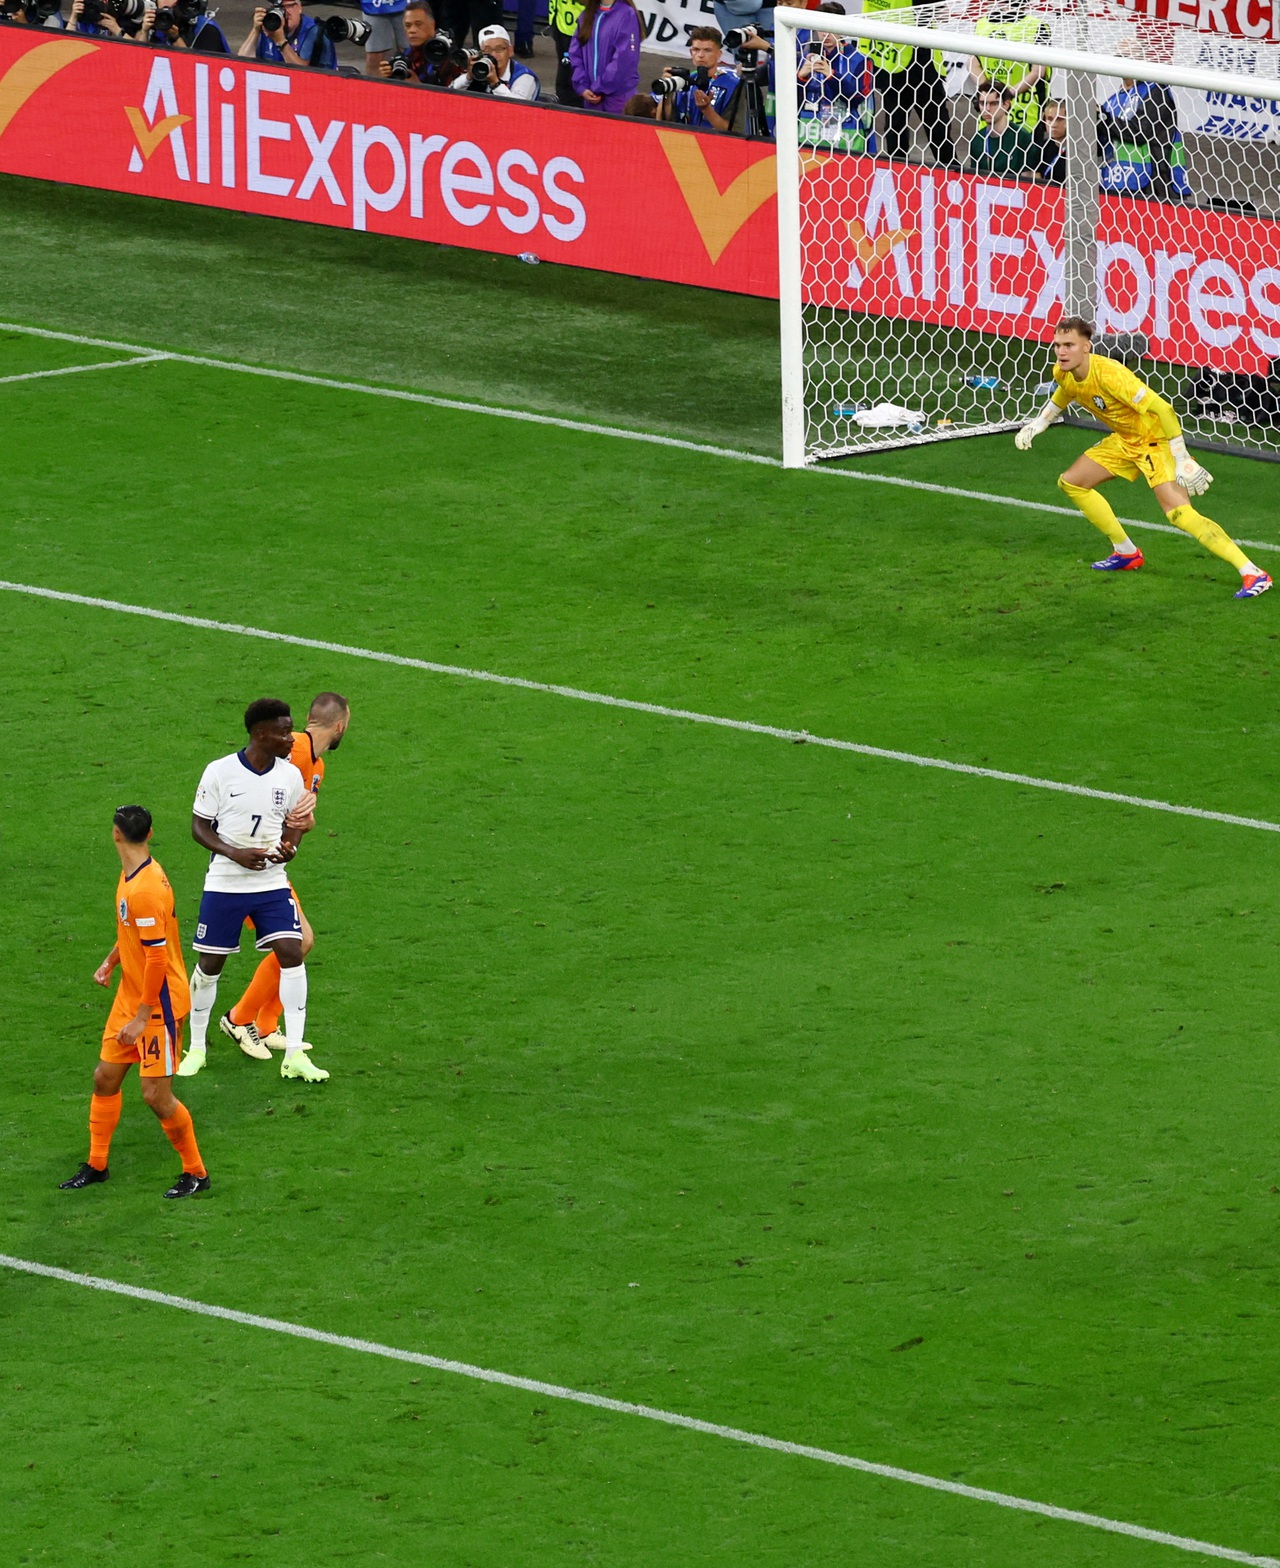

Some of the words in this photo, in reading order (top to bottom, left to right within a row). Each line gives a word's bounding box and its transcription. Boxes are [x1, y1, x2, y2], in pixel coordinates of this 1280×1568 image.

[124, 55, 587, 243] AliExpress
[1145, 454, 1155, 472] 1
[250, 814, 262, 838] 7
[288, 898, 299, 922] 7
[141, 1035, 161, 1060] 14
